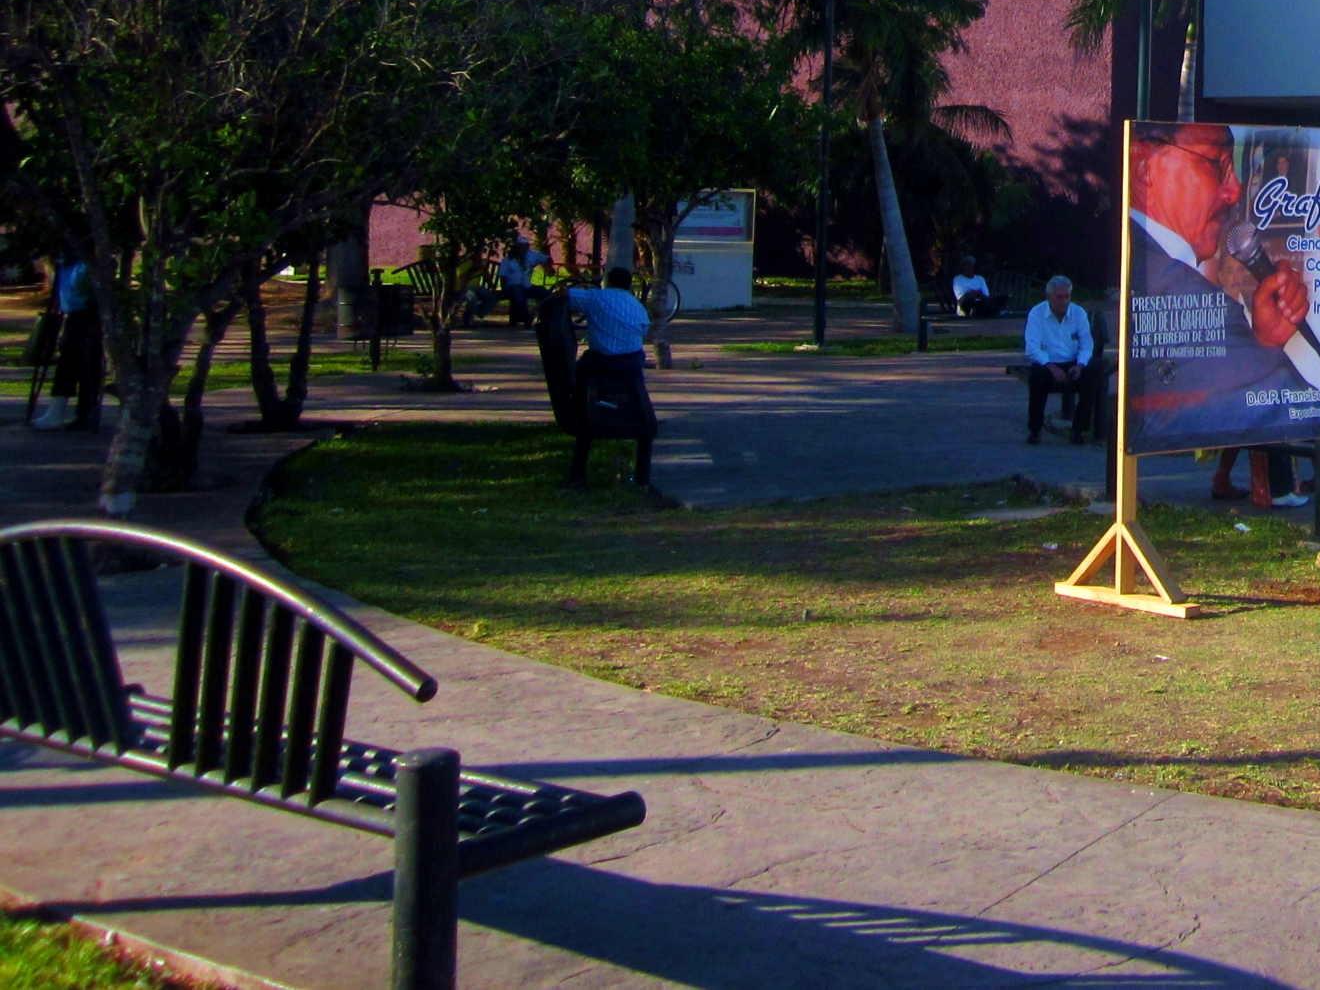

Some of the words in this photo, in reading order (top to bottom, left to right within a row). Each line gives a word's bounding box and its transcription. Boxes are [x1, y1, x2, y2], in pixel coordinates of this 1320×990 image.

[1132, 294, 1199, 312] PRESENTACION
[1202, 293, 1213, 308] DE
[1216, 292, 1227, 307] EL
[1158, 311, 1168, 332] DE
[1170, 310, 1179, 331] LA
[1132, 335, 1139, 347] 8
[1141, 334, 1151, 346] DE
[1153, 331, 1190, 345] FEBRERO
[1192, 330, 1204, 342] DE
[1205, 329, 1226, 342] 2011
[1246, 390, 1280, 406] D.C.P.
